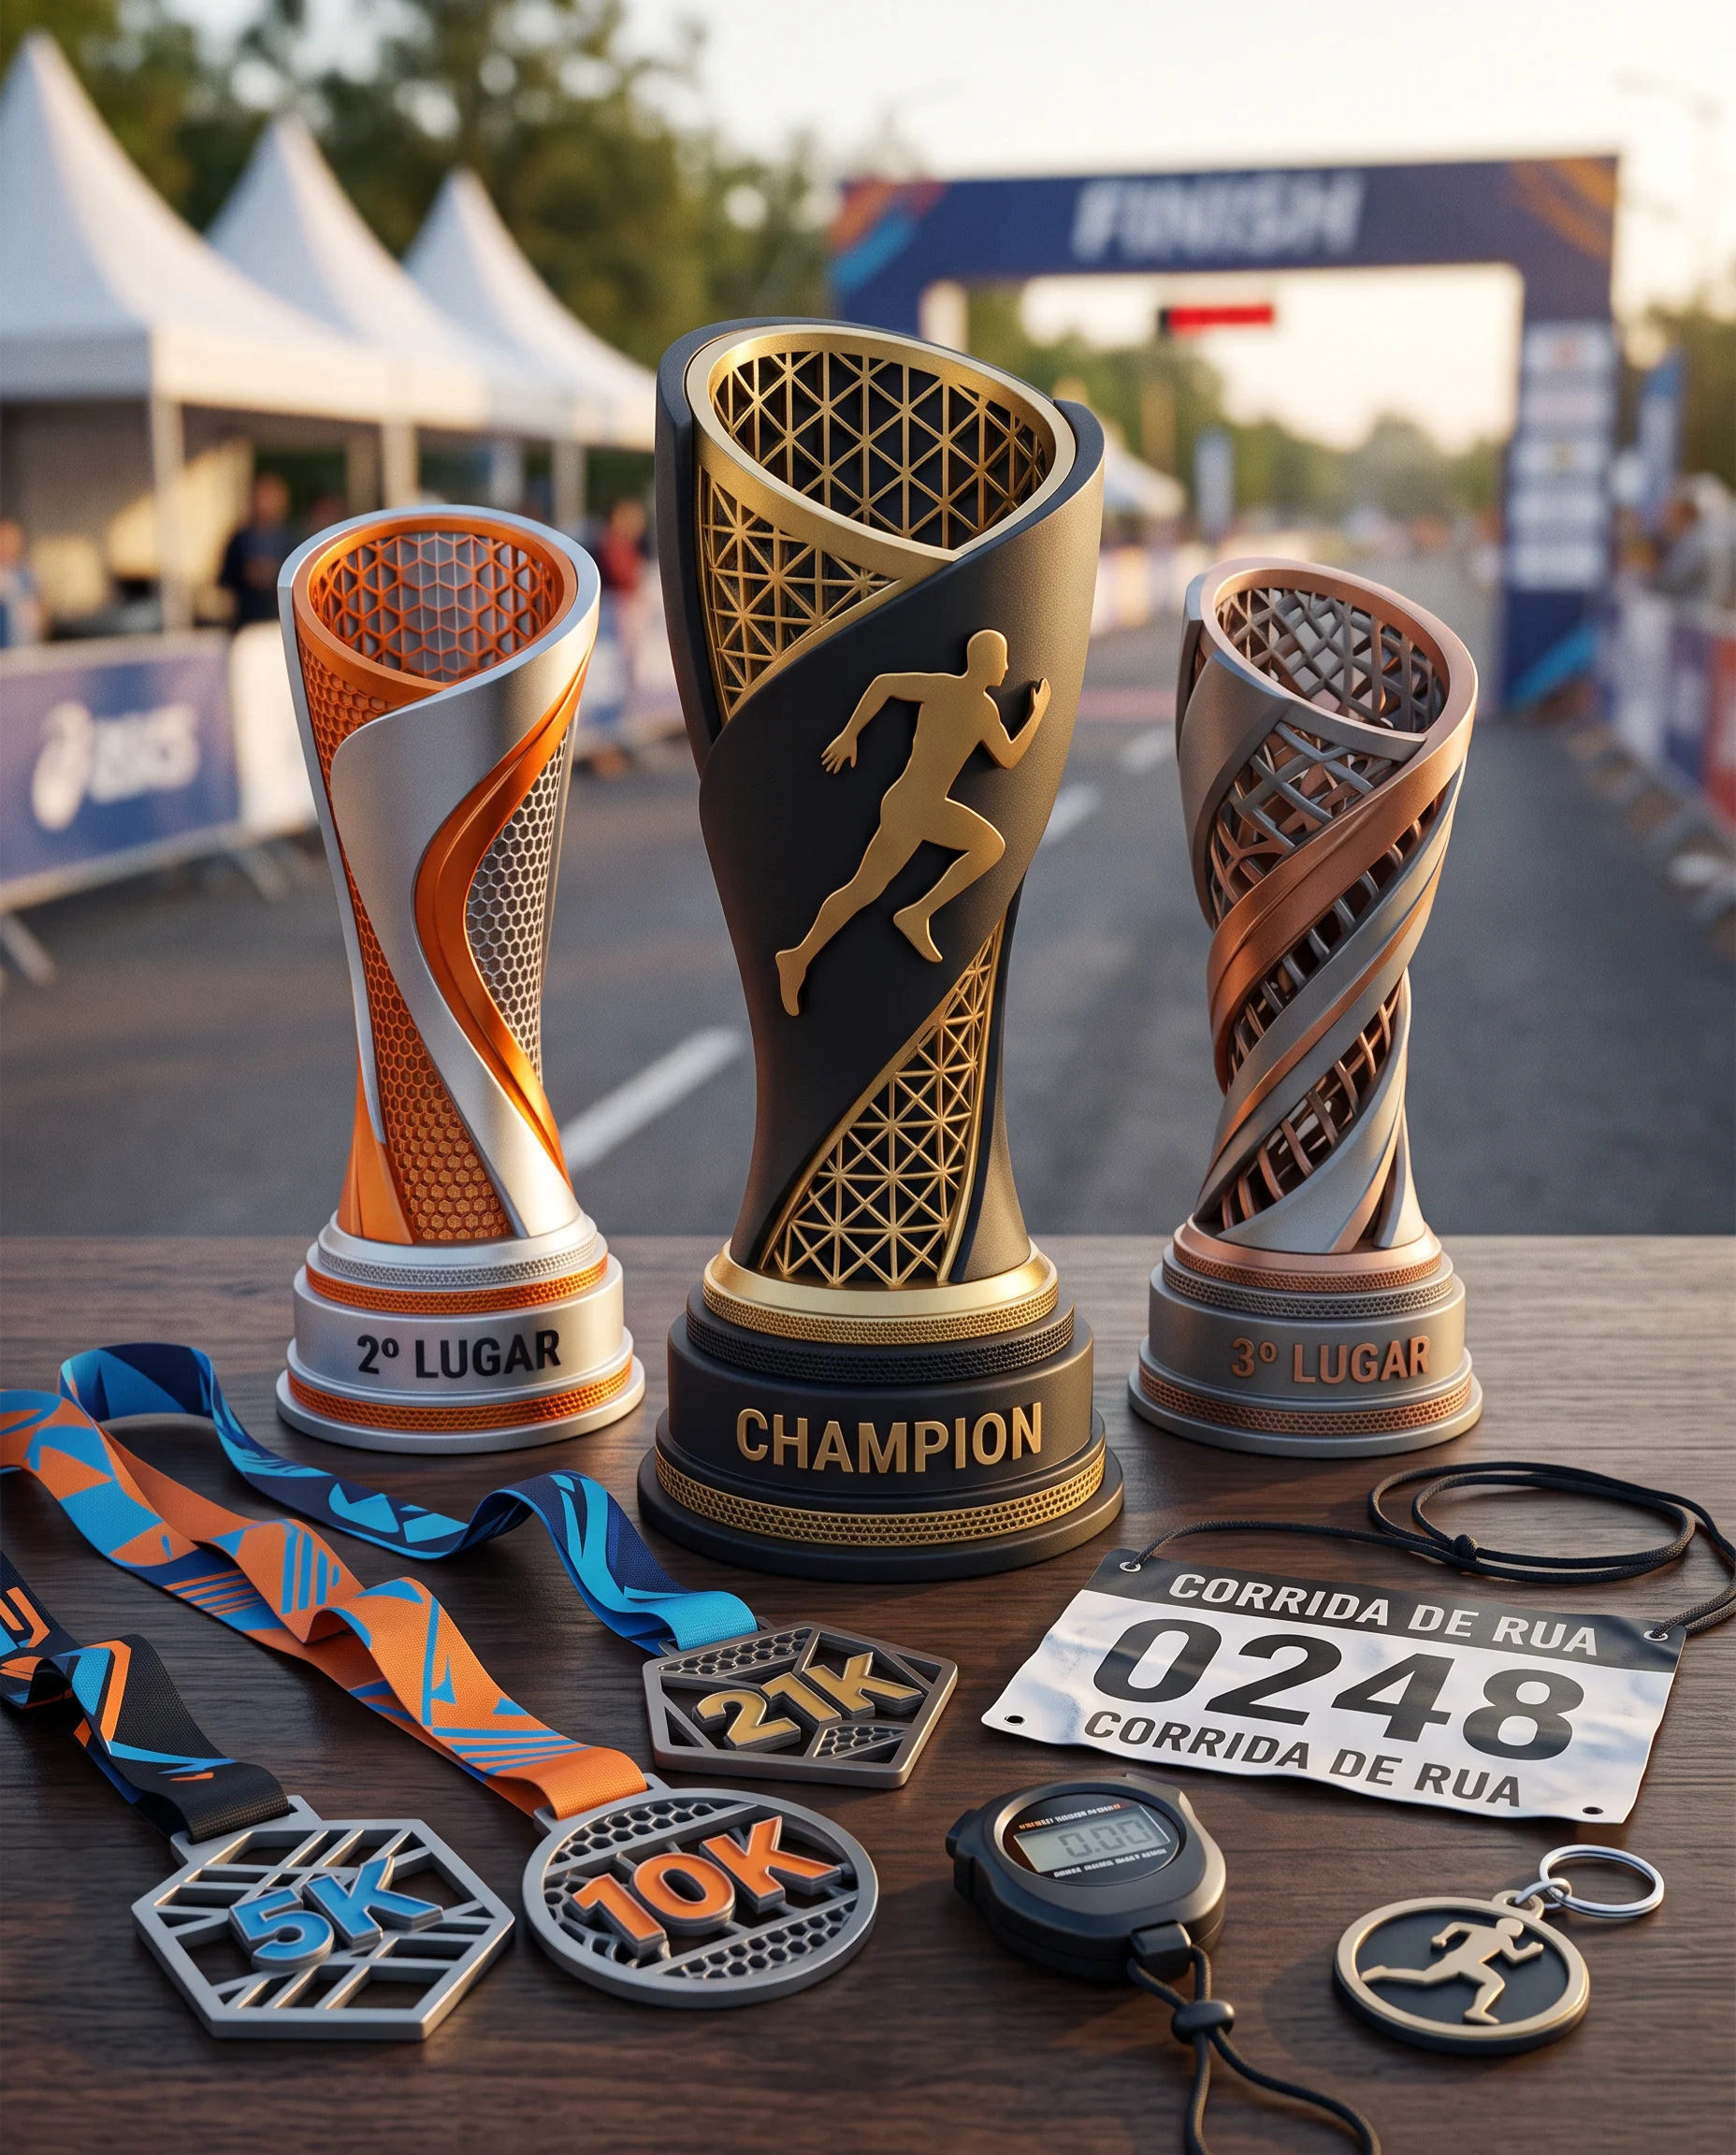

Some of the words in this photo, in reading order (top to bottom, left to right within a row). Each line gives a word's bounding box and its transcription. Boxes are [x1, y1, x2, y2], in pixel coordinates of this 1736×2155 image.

[1073, 170, 1362, 262] FINISH
[414, 1329, 561, 1379] LUGAR
[1293, 1335, 1431, 1384] LUGAR
[736, 1401, 1043, 1474] CHAMPION
[1168, 1572, 1389, 1627] CORRIDA
[1407, 1603, 1479, 1639] DE
[1491, 1615, 1599, 1656] RUA
[693, 1652, 924, 1747] 21K
[1092, 1618, 1585, 1761] 0248
[1083, 1710, 1309, 1771] CORRIDA
[1328, 1749, 1403, 1786] DE
[1413, 1770, 1522, 1808] RUA
[570, 1815, 841, 1947] 10K
[1058, 1819, 1153, 1858] 0.00
[229, 1856, 444, 1964] 5K
